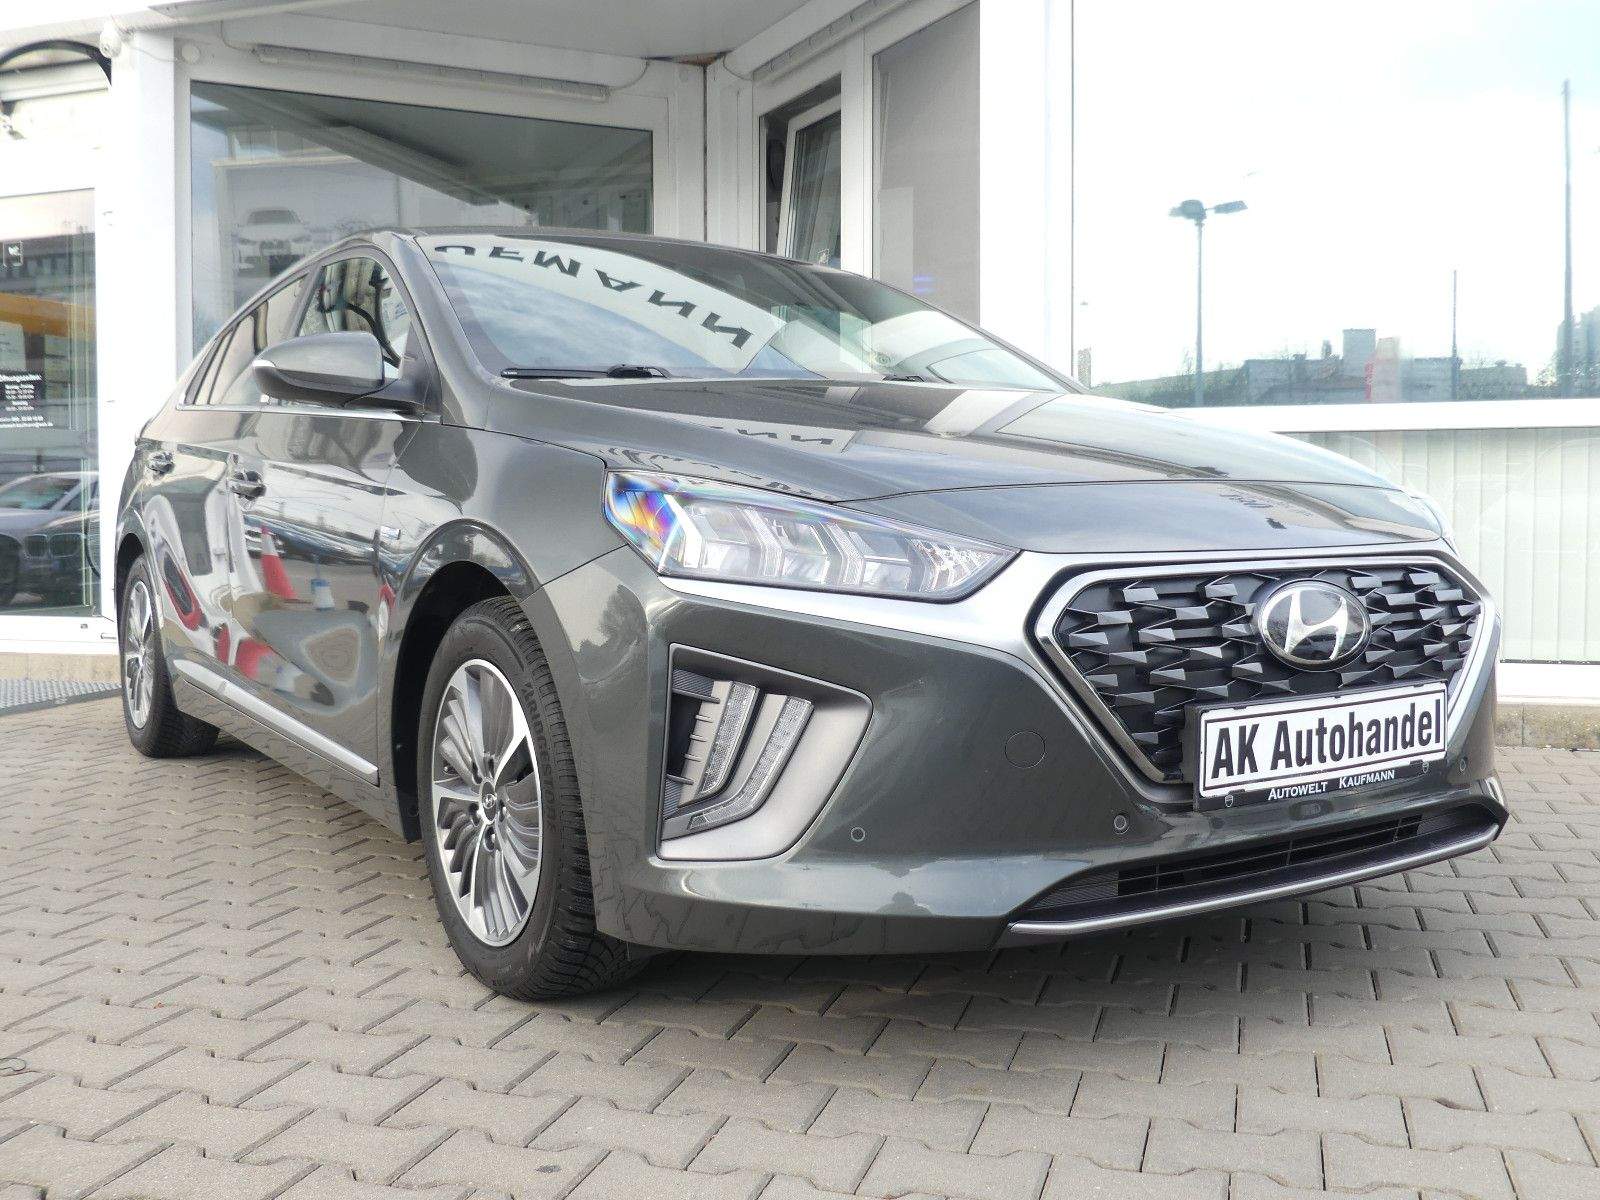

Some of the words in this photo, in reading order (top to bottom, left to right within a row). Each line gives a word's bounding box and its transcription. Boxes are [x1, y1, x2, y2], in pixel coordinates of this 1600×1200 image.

[1211, 723, 1258, 779] AK
[1270, 699, 1440, 770] Autohandel
[1268, 781, 1328, 801] AUTOWELT
[1339, 770, 1395, 789] KAUFMANN
